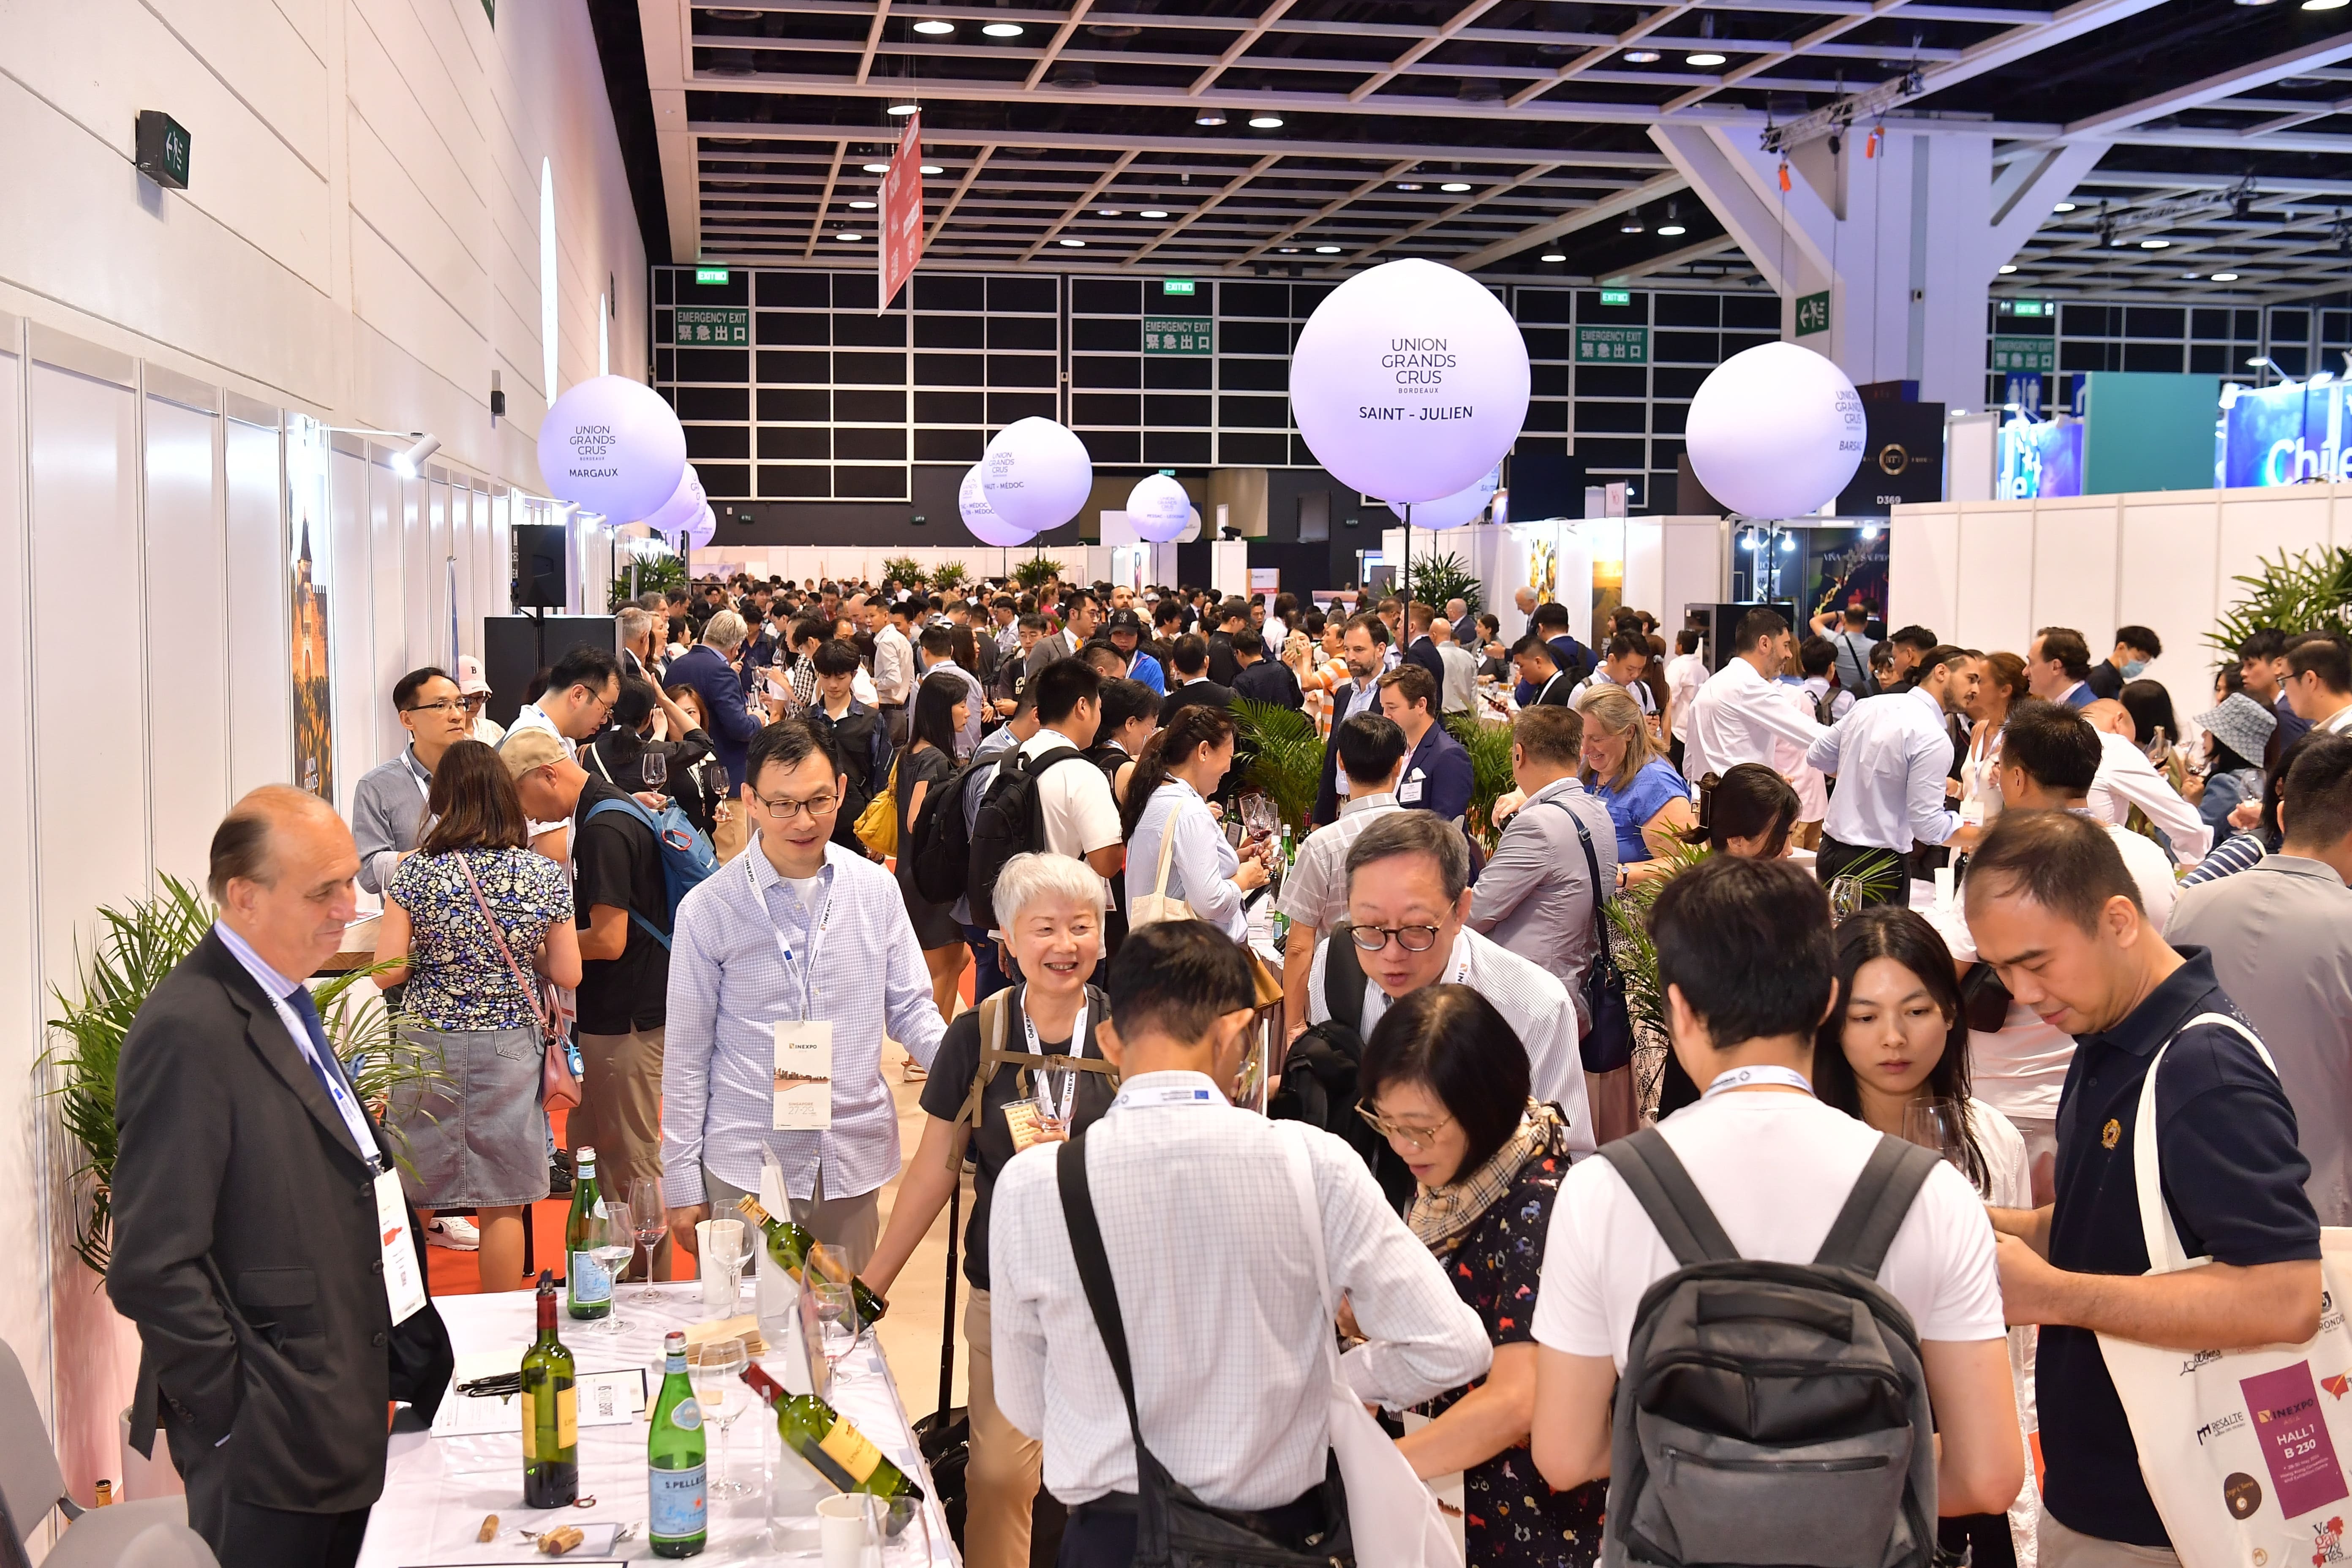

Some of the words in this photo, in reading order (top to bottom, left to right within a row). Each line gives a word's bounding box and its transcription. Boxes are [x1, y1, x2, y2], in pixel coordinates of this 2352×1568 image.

[678, 312, 727, 323] EMERGENCY
[729, 313, 746, 323] EXIT
[1145, 321, 1192, 332] EMERGENCY
[1194, 322, 1210, 332] EXIT
[678, 325, 746, 341] 緊急出口
[1581, 330, 1625, 341] EMERGENCY
[1626, 331, 1642, 342] EXIT
[1146, 334, 1210, 350] 緊急出口
[1392, 338, 1447, 351] UNION
[1382, 354, 1456, 368] GRANDS
[1396, 370, 1442, 384] CRUS
[1359, 406, 1405, 420] SAINT
[1419, 406, 1473, 420] JULIEN
[576, 425, 610, 435] UNION
[569, 436, 616, 445] GRANDS
[577, 446, 606, 455] CRUS
[569, 468, 618, 478] MARGAUX
[999, 481, 1024, 489] MÉDOC
[1876, 495, 1901, 504] D369
[471, 666, 477, 674] B
[2211, 1411, 2244, 1432] RESALTE
[2276, 1428, 2309, 1446] HALL
[2309, 1424, 2315, 1433] 1
[2284, 1447, 2295, 1459] B
[2296, 1439, 2316, 1455] 230
